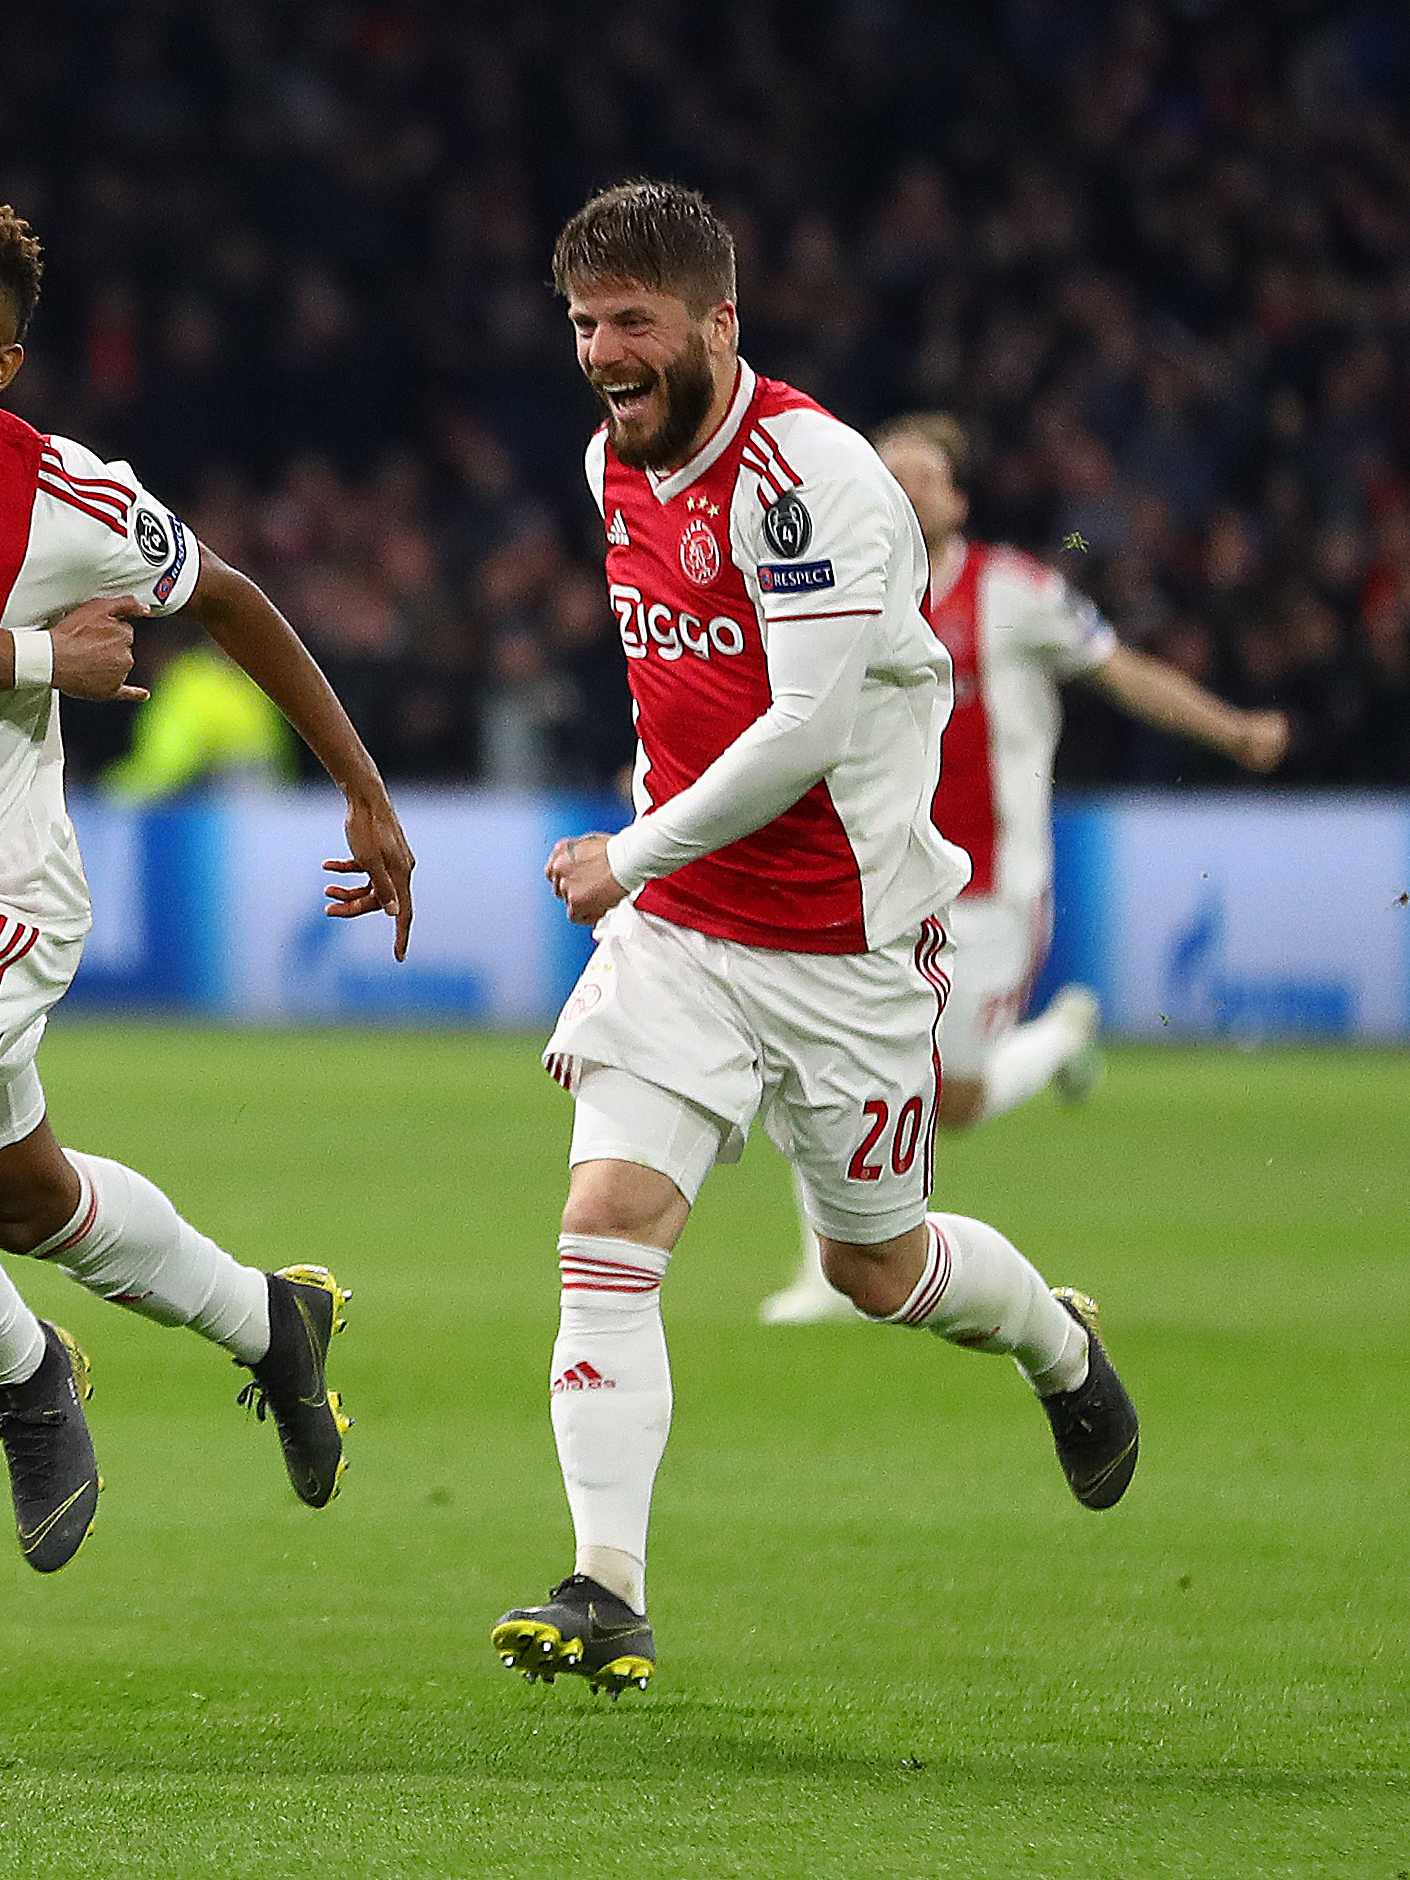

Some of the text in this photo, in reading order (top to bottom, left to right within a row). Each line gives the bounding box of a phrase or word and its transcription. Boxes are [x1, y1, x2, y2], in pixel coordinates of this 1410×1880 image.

[782, 525, 793, 544] 4
[773, 567, 831, 587] RESPECT
[847, 1095, 923, 1181] 20
